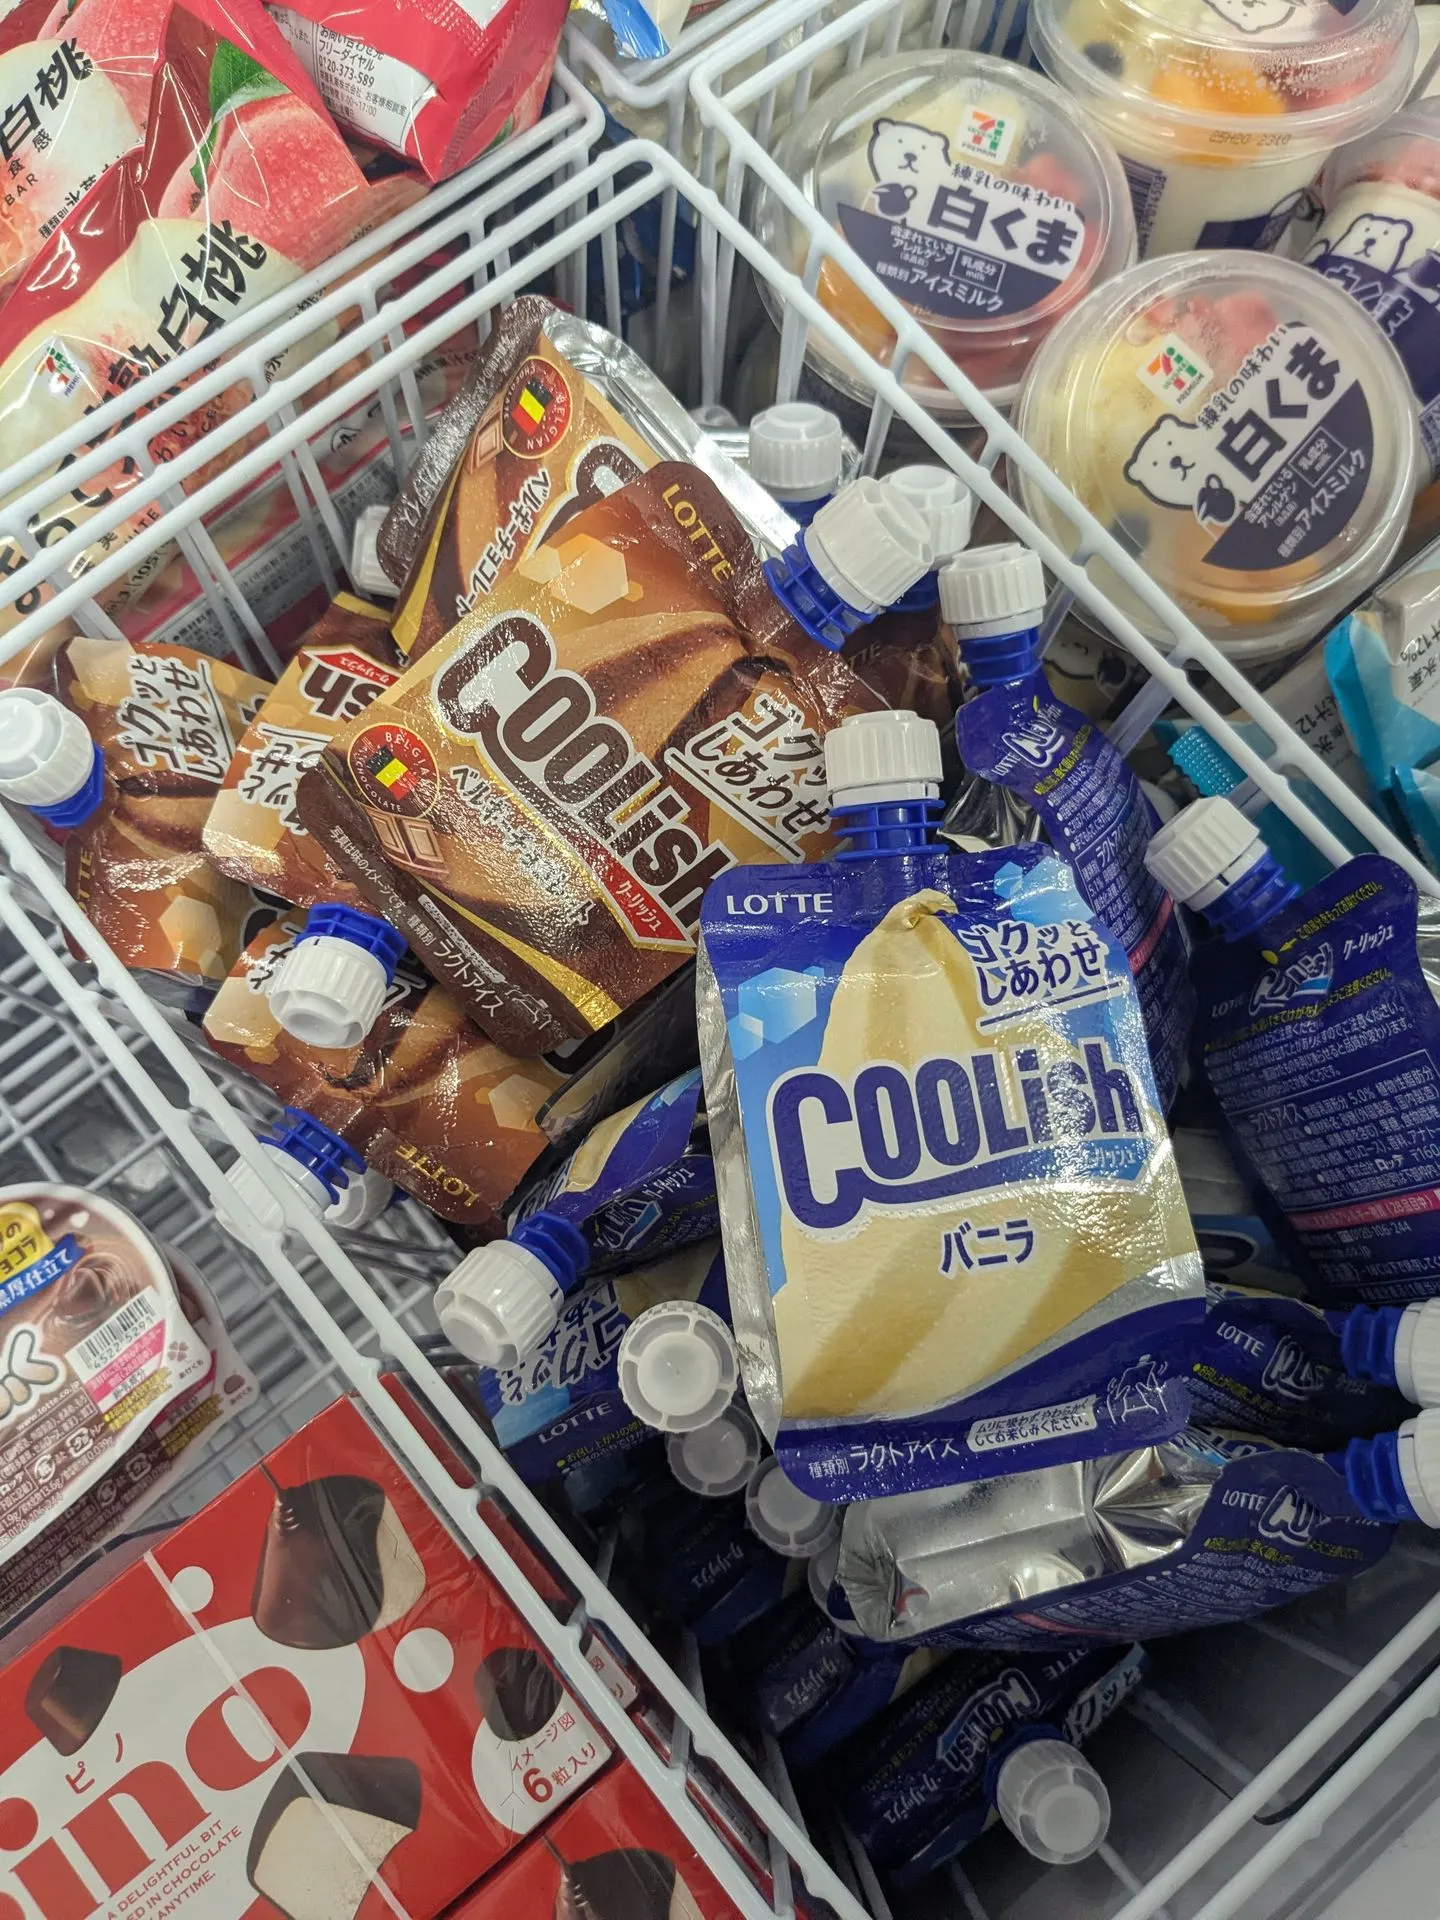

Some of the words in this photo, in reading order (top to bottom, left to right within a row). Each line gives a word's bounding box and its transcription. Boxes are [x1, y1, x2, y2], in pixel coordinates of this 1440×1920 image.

[319, 39, 375, 72] フリーダイヤル
[951, 163, 1073, 212] 練乳の味わい
[926, 184, 1079, 266] 白くま
[909, 266, 1004, 313] アイスミルク
[1198, 326, 1288, 431] 練乳の味わい
[1216, 336, 1341, 483] 白くま
[662, 483, 737, 584] LOTTE
[617, 879, 666, 932] クーリッシュ
[726, 893, 834, 914] LOTTE
[958, 919, 1089, 963] ゴクッと
[1343, 924, 1395, 960] クーリッシュ
[434, 940, 506, 1019] ラクトアイス
[976, 938, 1102, 1008] しあわせ
[773, 1042, 1144, 1229] COOLish
[398, 1141, 481, 1208] LOTTE
[940, 1220, 1036, 1273] バニラ
[538, 1402, 613, 1444] LOTTE
[808, 1459, 850, 1479] 種類別
[850, 1438, 959, 1471] ラクトアイス
[65, 1733, 124, 1794] ピノ
[511, 1712, 576, 1773] イメージ図
[118, 1844, 200, 1914] DELIGHTFUL
[199, 1819, 225, 1844] BIT
[144, 1892, 162, 1910] IN
[161, 1824, 243, 1896] CHOCOLATE
